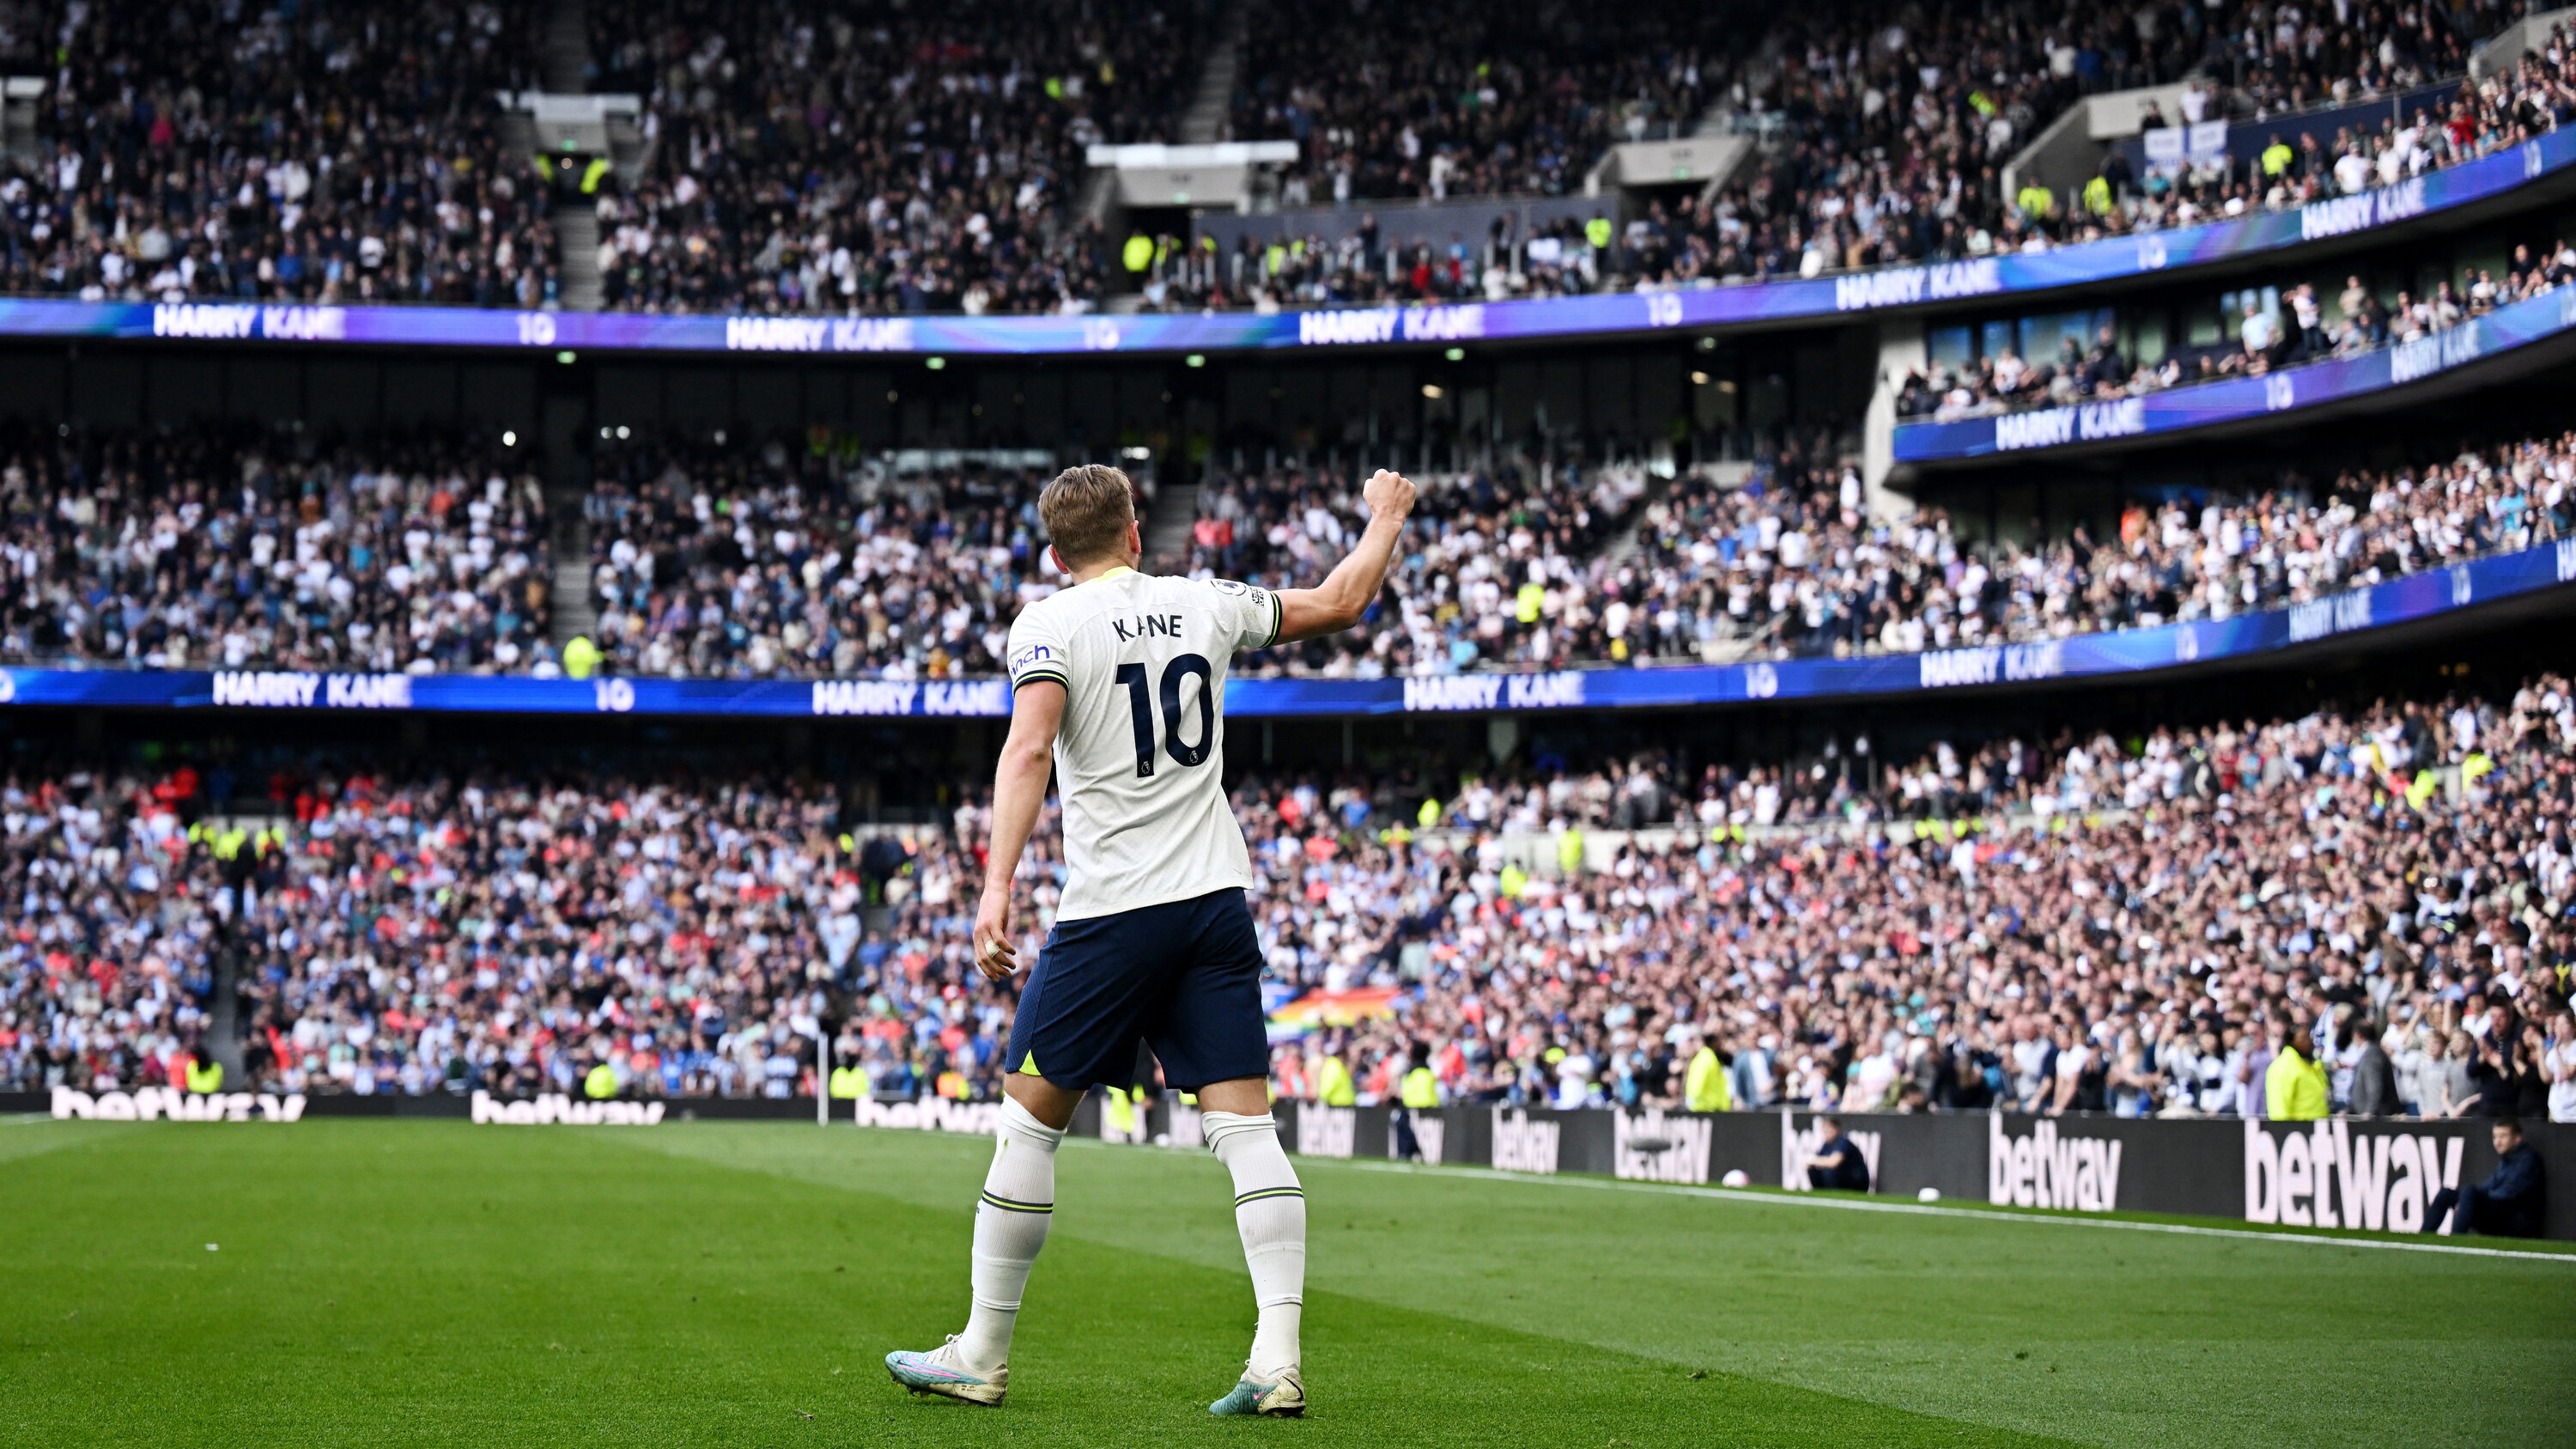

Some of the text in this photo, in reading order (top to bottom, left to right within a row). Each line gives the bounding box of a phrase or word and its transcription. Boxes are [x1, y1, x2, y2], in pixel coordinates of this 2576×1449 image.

[1836, 257, 2002, 310] HARRY KANE
[154, 303, 345, 341] HARRY KANE
[1299, 304, 1485, 345] HARRY KANE
[1646, 292, 1683, 326] 10
[517, 313, 556, 345] 10
[726, 317, 914, 350] HARRY KANE
[2265, 372, 2293, 411] 10
[1996, 397, 2145, 451] HARRY KANE
[1112, 614, 1182, 642] KANE
[1745, 663, 1778, 699] 10
[1920, 639, 2063, 688] HARRY KANE
[212, 671, 412, 709] HARRY KANE
[595, 678, 635, 713] 10
[812, 680, 1011, 716] HARRY KANE
[1403, 670, 1586, 712] HARRY KANE
[1115, 653, 1214, 778] 10
[854, 1094, 1003, 1135] betwa
[1989, 1110, 2123, 1212] betway
[2245, 1117, 2465, 1235] betway
